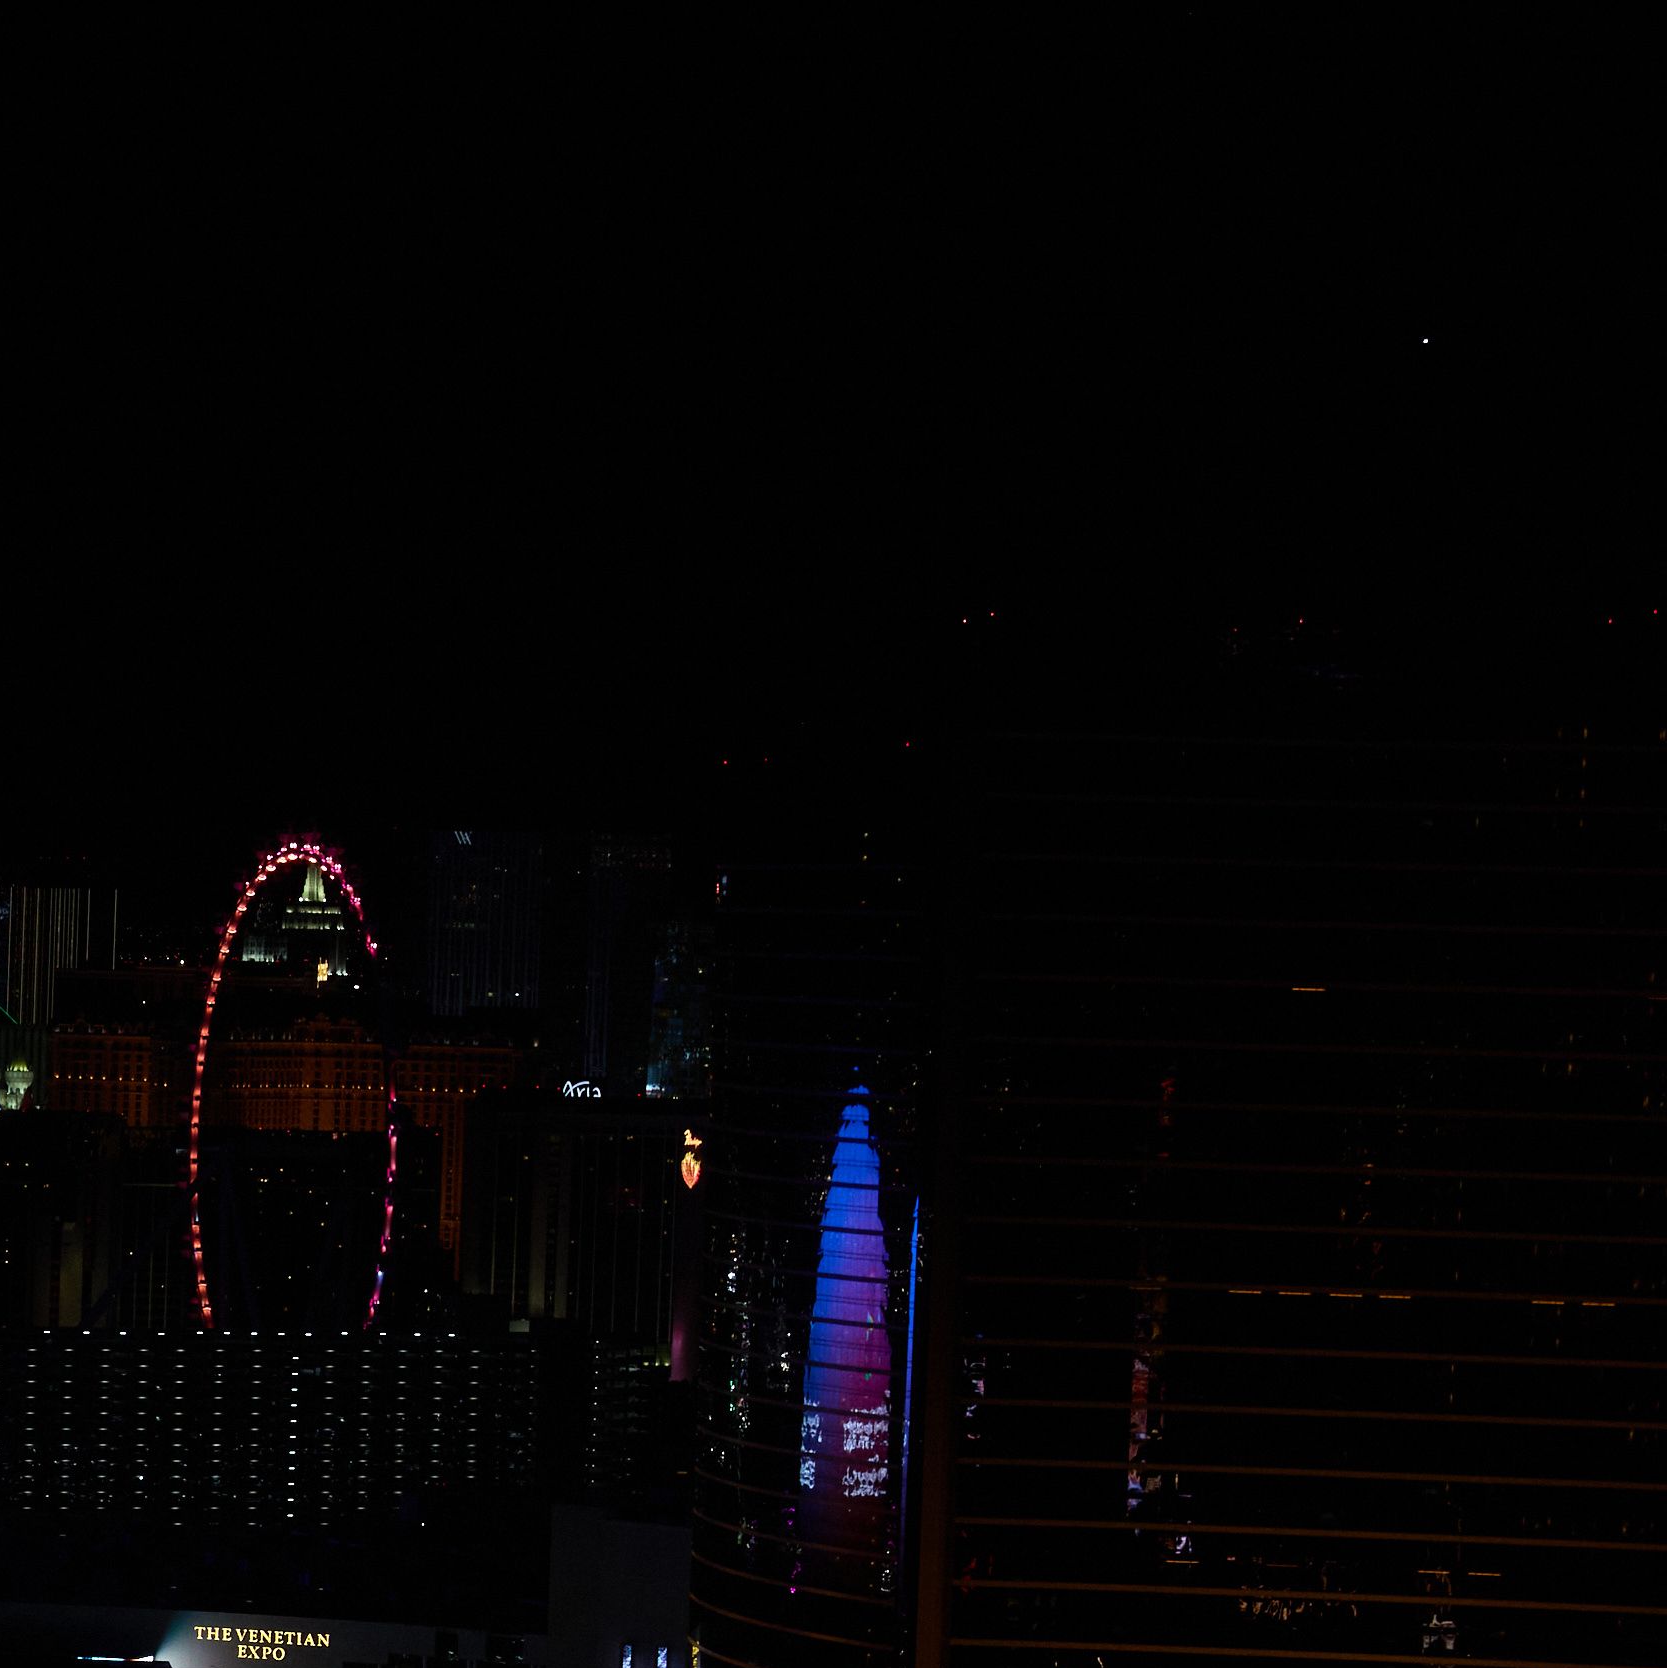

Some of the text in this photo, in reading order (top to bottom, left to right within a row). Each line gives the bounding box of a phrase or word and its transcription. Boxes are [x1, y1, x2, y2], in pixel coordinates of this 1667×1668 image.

[193, 1626, 330, 1647] THE VENETIAN
[237, 1644, 286, 1661] EXPO
